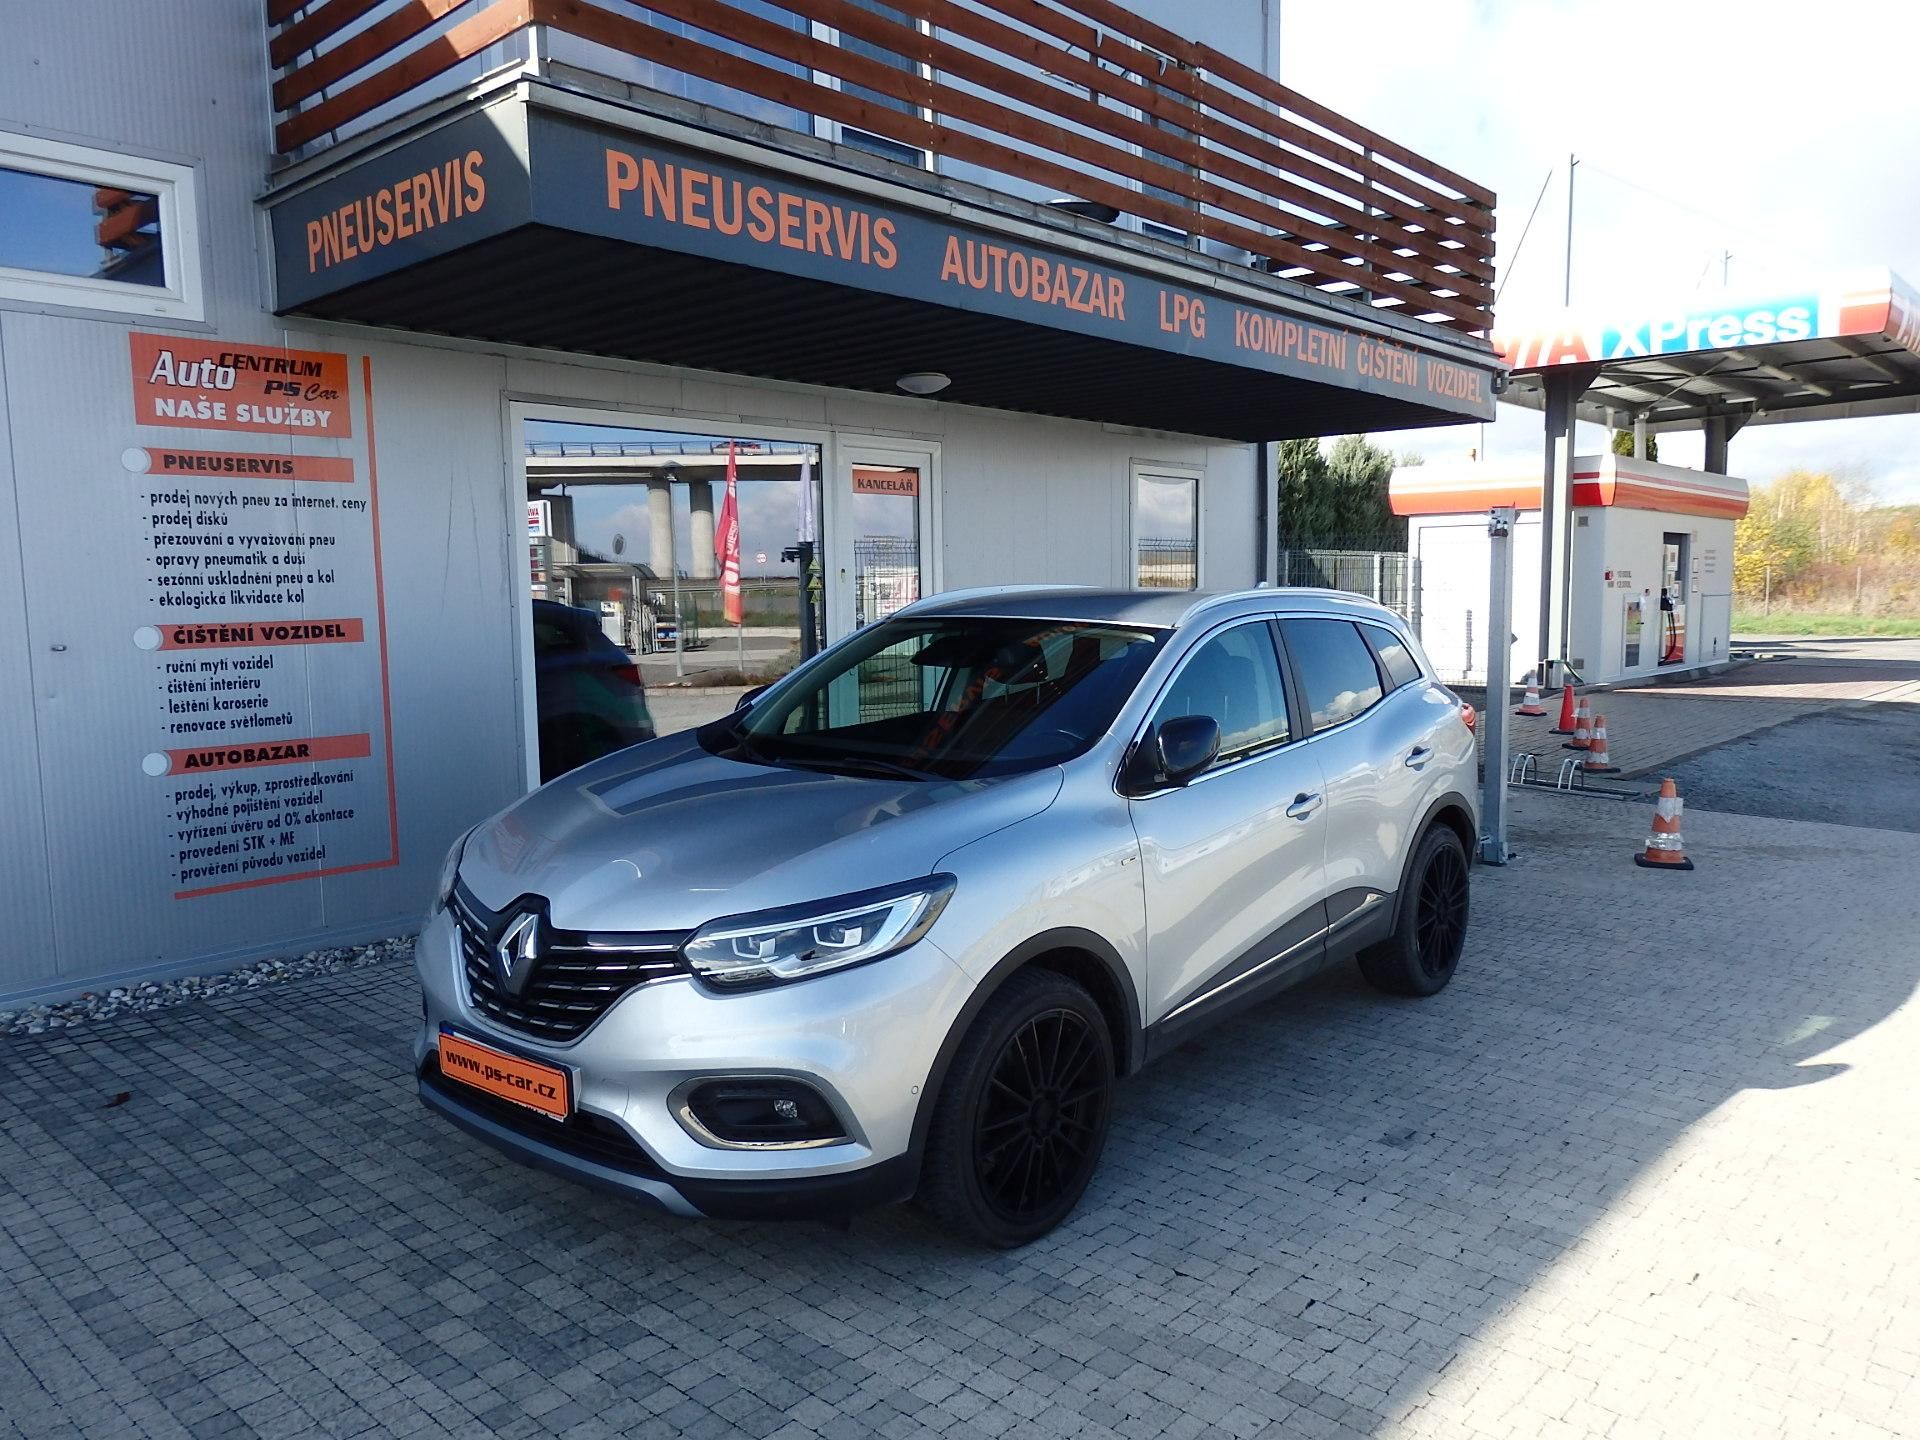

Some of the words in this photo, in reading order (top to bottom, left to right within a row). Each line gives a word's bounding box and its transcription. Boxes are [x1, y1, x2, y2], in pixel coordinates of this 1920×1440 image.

[307, 150, 486, 273] PNEUSERVIS
[606, 148, 897, 269] PNEUSERVIS
[941, 235, 1126, 321] AUTOBAZAR
[1160, 290, 1206, 339] LPG
[1236, 309, 1347, 369] KOMPLETNÍ
[1357, 333, 1418, 387] ČIŠTĚNÍ
[1427, 361, 1482, 404] VOZIDEL
[149, 349, 237, 391] Auto
[219, 352, 323, 377] CENTRUM
[264, 380, 302, 397] PS
[304, 383, 339, 401] Car
[155, 395, 227, 421] NAŠE
[237, 403, 332, 428] SLUŽBY
[163, 454, 293, 474] PNEUSERVIS
[857, 477, 914, 492] KANCELÁŘ
[150, 489, 190, 508] prodej
[194, 490, 238, 508] nových
[242, 495, 270, 509] pneu
[274, 496, 288, 507] za
[341, 499, 367, 513] ceny
[152, 510, 192, 529] prodej
[226, 536, 234, 545] a
[239, 533, 305, 549] vyvažování
[309, 536, 335, 549] pneu
[156, 556, 200, 569] opravy
[205, 551, 267, 569] pneumatik
[272, 555, 279, 565] a
[276, 574, 303, 587] pneu
[306, 574, 314, 584] a
[317, 569, 335, 583] kol
[230, 589, 283, 605] likvidace
[287, 588, 305, 603] kol
[173, 624, 254, 644] ČIŠTĚNÍ
[260, 624, 346, 640] VOZIDEL
[166, 659, 196, 673] ruční
[232, 654, 274, 670] vozidel
[167, 678, 206, 693] čištění
[210, 675, 261, 691] interiéru
[169, 698, 209, 713] leštění
[213, 694, 269, 710] karoserie
[170, 719, 226, 733] renovace
[230, 712, 293, 729] světlometů
[185, 744, 310, 768] AUTOBAZAR
[175, 783, 217, 805] prodej,
[221, 780, 260, 799] výkup,
[176, 802, 229, 824] výhodné
[284, 789, 323, 807] vozidel
[178, 822, 227, 843] vyřízení
[231, 819, 263, 834] úvěru
[267, 814, 280, 829] od
[284, 811, 301, 827] 0%
[304, 809, 354, 824] akontace
[179, 840, 239, 864] provedení
[243, 835, 265, 851] STK
[280, 831, 295, 847] ME
[181, 859, 238, 883] prověření
[242, 852, 283, 873] původu
[287, 845, 326, 863] vozidel
[446, 1050, 557, 1100] www.ps-car.cz
